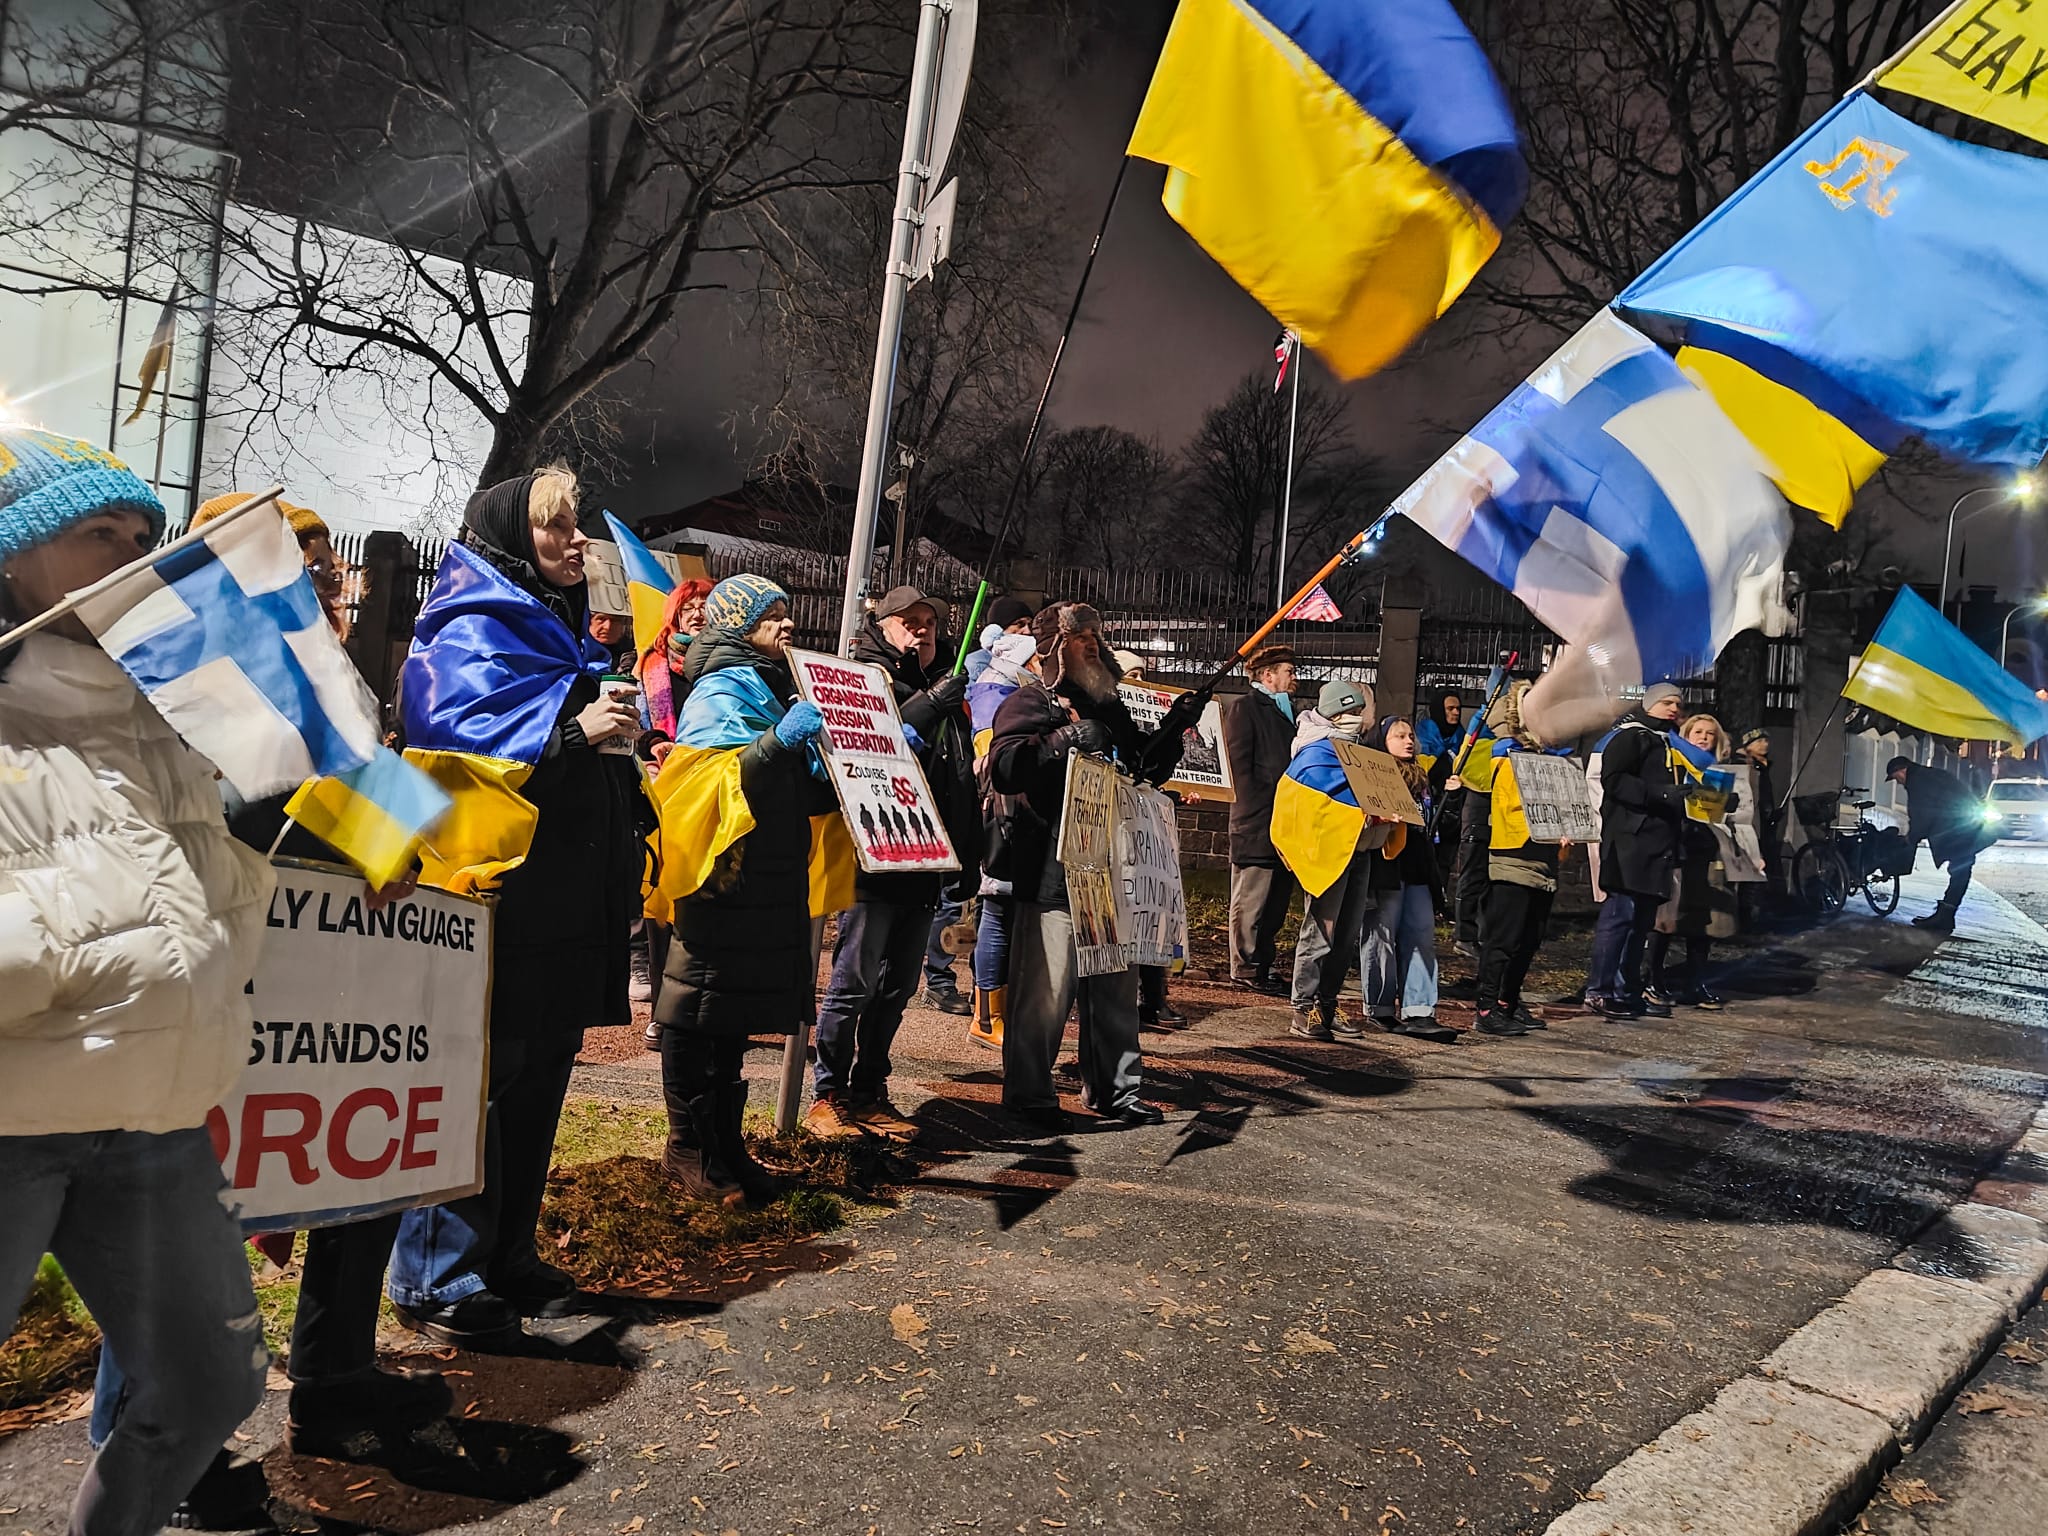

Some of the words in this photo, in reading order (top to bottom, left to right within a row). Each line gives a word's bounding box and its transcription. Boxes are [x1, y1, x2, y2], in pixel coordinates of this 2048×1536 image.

[804, 663, 867, 691] TERRORIST
[812, 686, 889, 715] ORGANISATION
[1135, 693, 1145, 704] IS
[822, 708, 874, 730] RUSSIAN
[830, 730, 896, 755] FEDERATION
[1336, 743, 1361, 767] US
[842, 763, 888, 781] ZOLDIERS
[1170, 771, 1189, 781] IAN
[1190, 773, 1223, 785] TERROR
[871, 784, 881, 796] OF
[318, 891, 475, 952] LANGUAGE
[406, 1025, 429, 1062] IS
